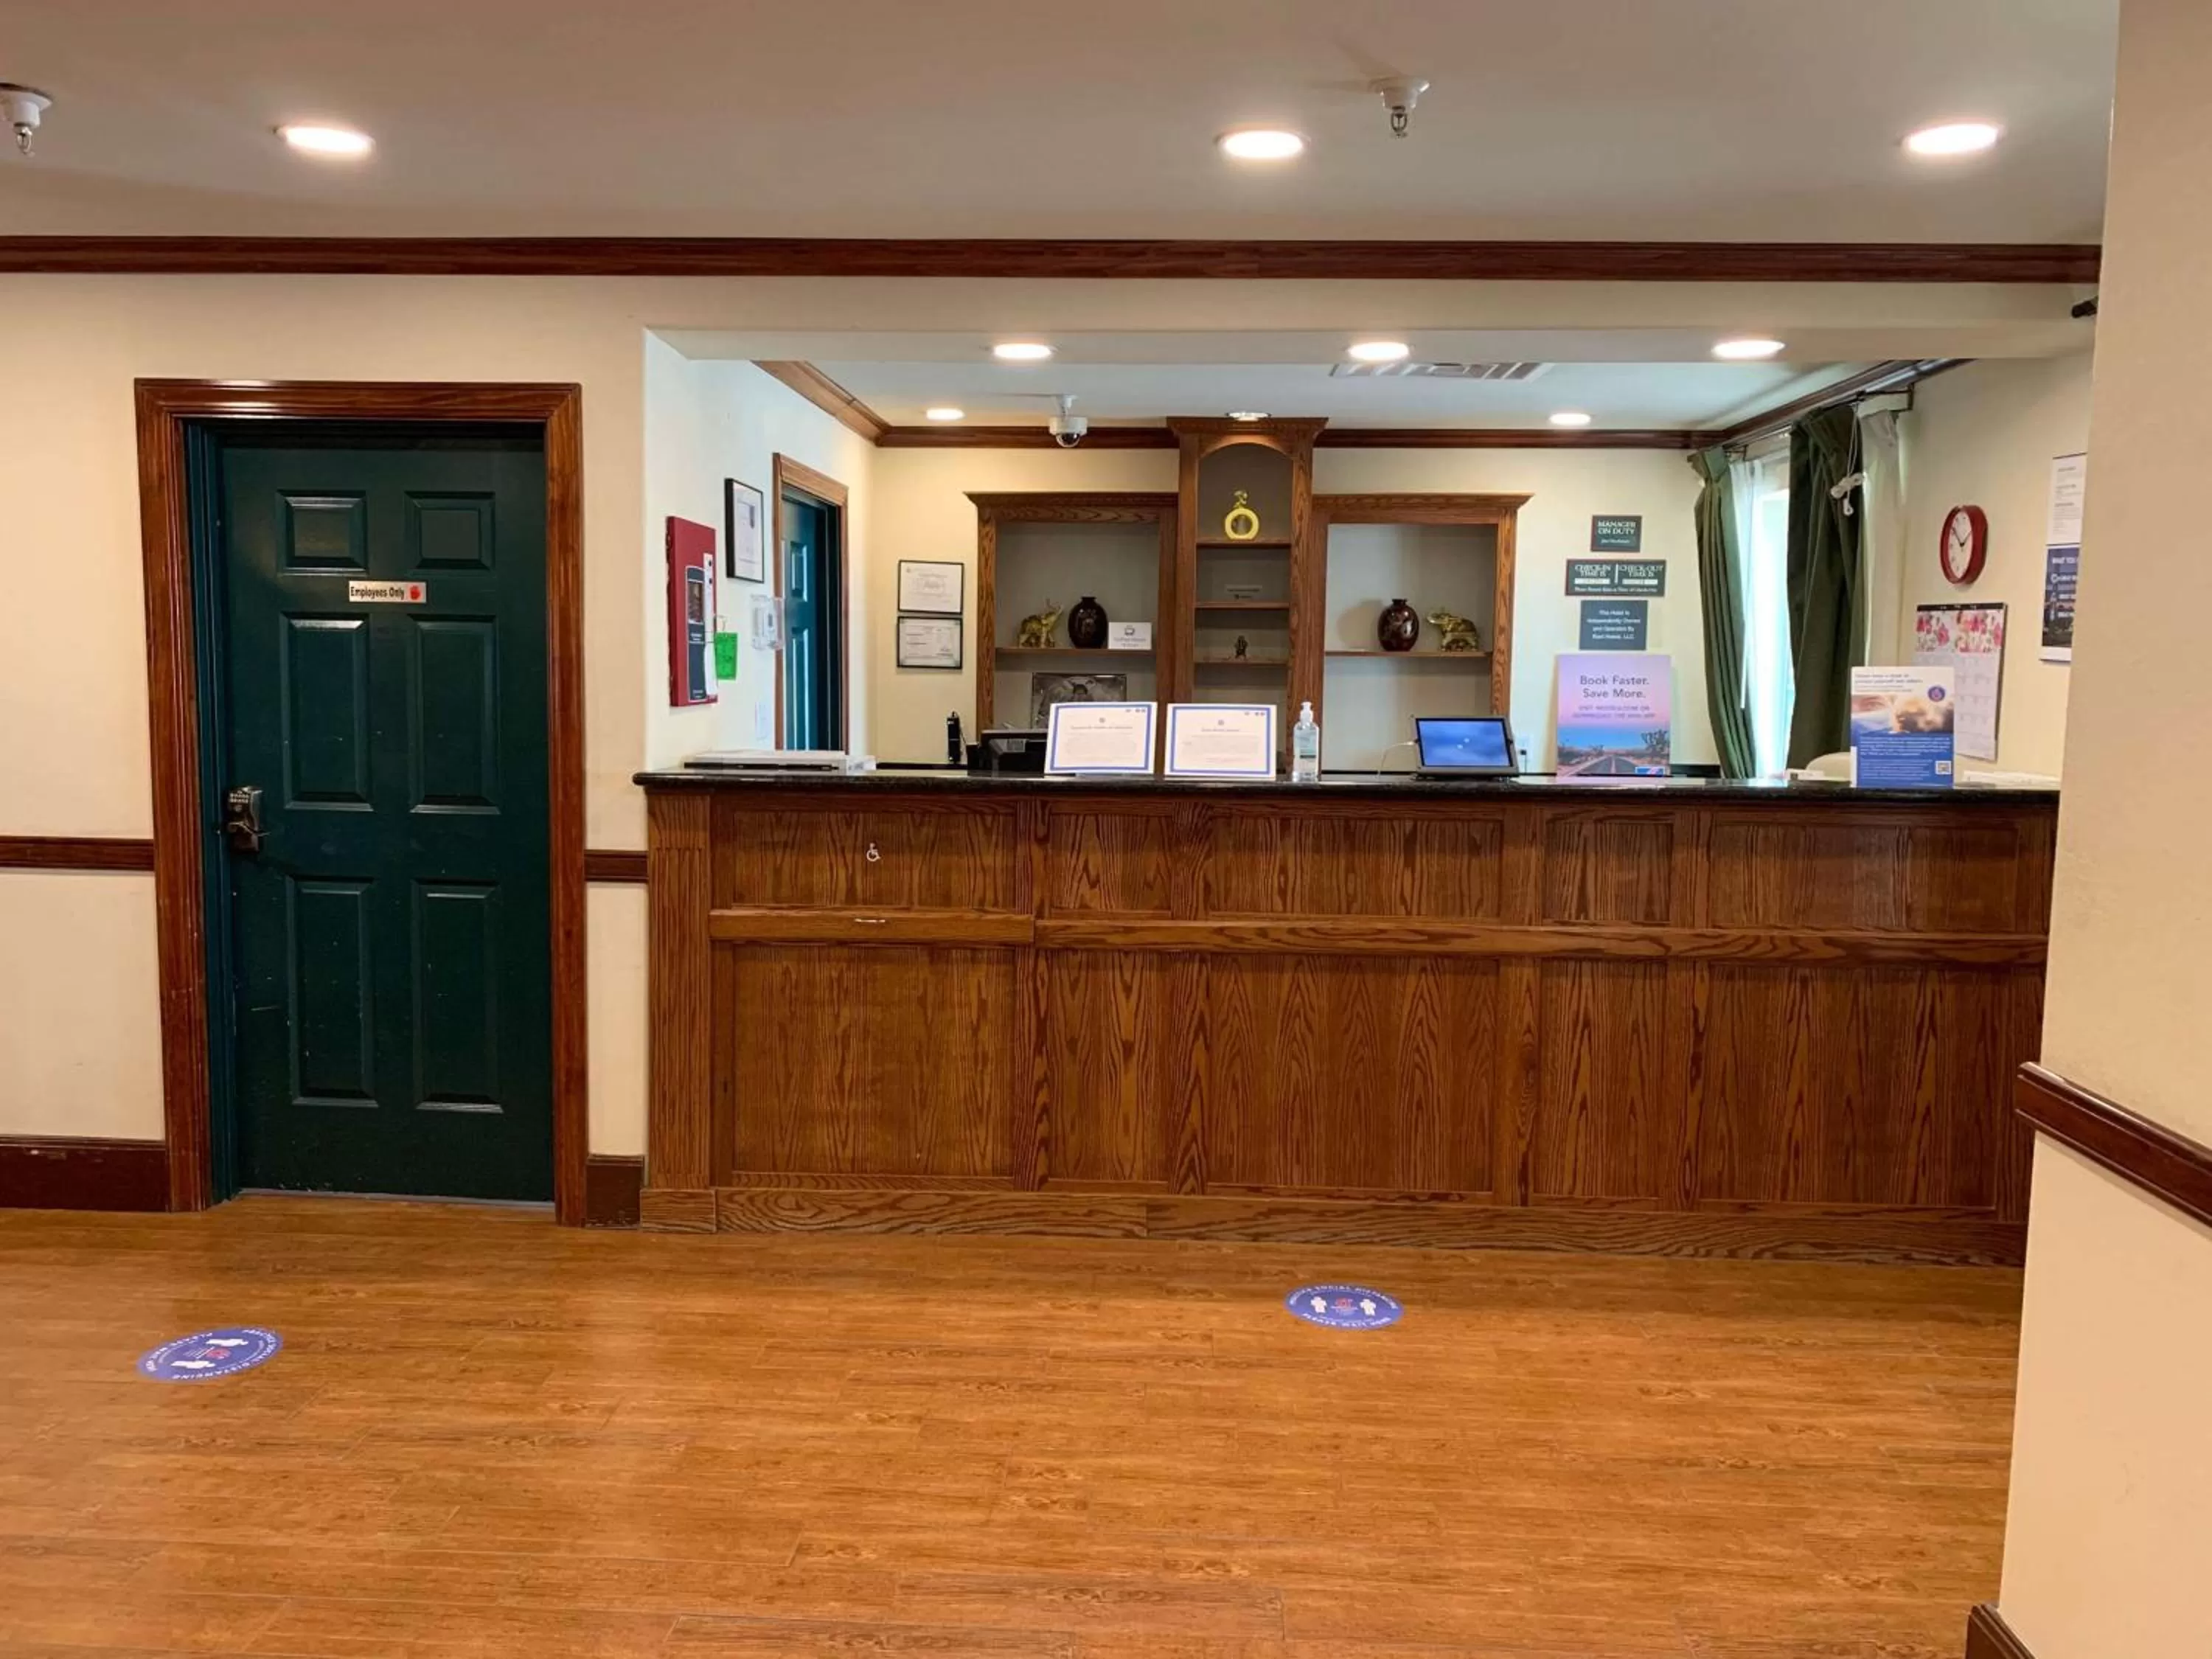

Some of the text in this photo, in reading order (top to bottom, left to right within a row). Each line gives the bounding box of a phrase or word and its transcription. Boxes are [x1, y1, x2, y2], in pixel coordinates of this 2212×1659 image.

[350, 586, 405, 600] Employees Only
[1580, 675, 1649, 685] Book Faster.
[1583, 688, 1646, 698] Save More.
